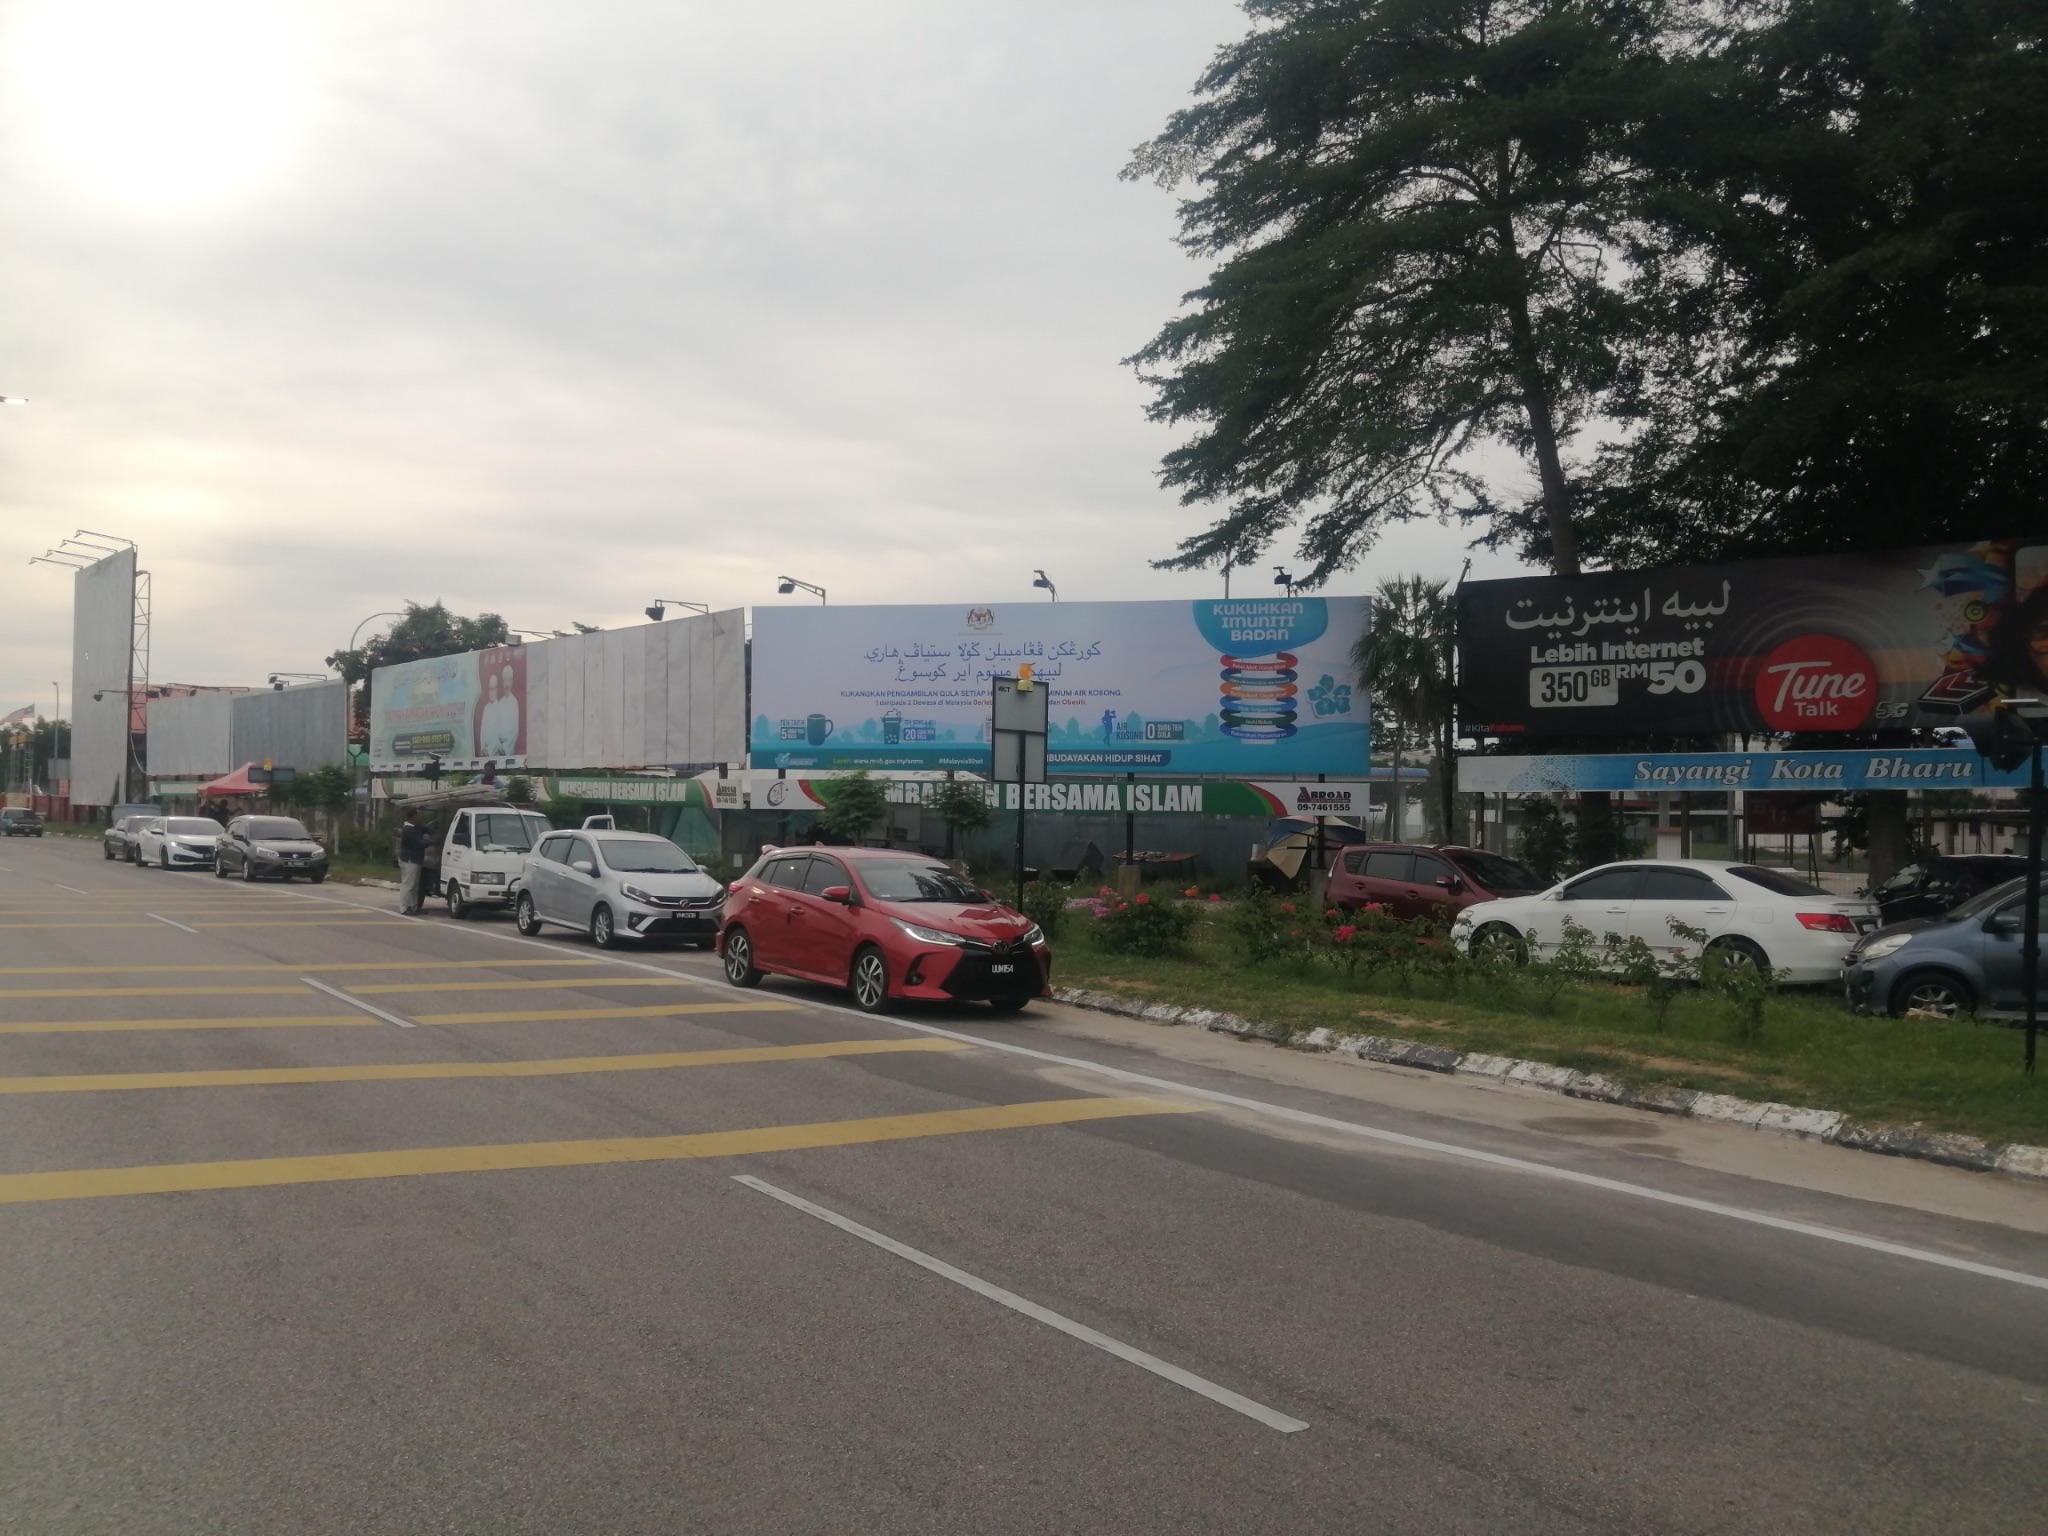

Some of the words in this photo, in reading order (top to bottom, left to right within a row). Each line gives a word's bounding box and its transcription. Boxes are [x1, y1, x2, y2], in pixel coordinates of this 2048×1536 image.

[1213, 602, 1303, 615] KUKUHKAN
[1231, 629, 1289, 641] BADAN
[1531, 642, 1597, 663] Lebih
[1602, 637, 1705, 660] Internet
[1767, 661, 1866, 713] Tune
[1793, 701, 1838, 717] Talk
[1876, 701, 1909, 719] 5G
[905, 729, 916, 740] 20
[1116, 722, 1128, 731] AIR
[1105, 754, 1134, 762] HIDUP
[1135, 754, 1162, 762] SIHAT
[1634, 759, 1752, 785] Sayangi
[1770, 759, 1844, 780] Kota
[1864, 757, 1974, 780] Bharu
[656, 782, 686, 802] ISLAM
[1006, 783, 1121, 811] BERSAMA
[1127, 784, 1202, 812] ISLAM
[1297, 787, 1351, 803] ABROAD
